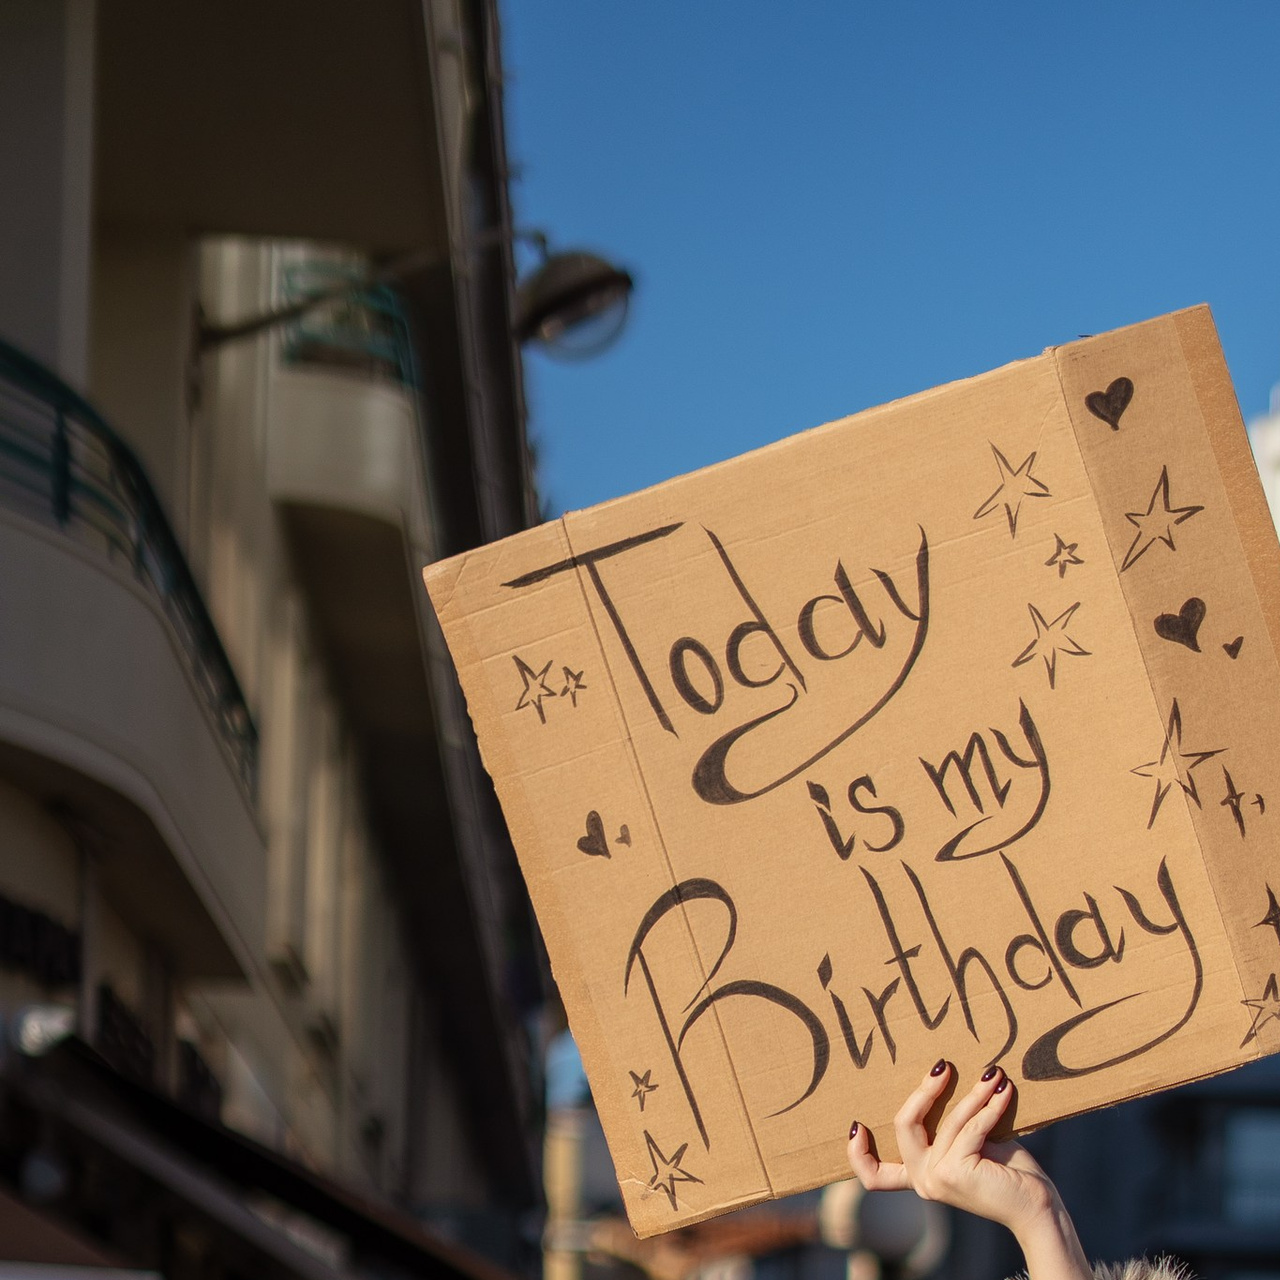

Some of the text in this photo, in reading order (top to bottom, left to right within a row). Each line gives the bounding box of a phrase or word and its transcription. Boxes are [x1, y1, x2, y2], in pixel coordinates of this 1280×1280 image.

[500, 522, 930, 806] Today
[806, 696, 1052, 863] is my
[623, 851, 1203, 1152] Birthday
